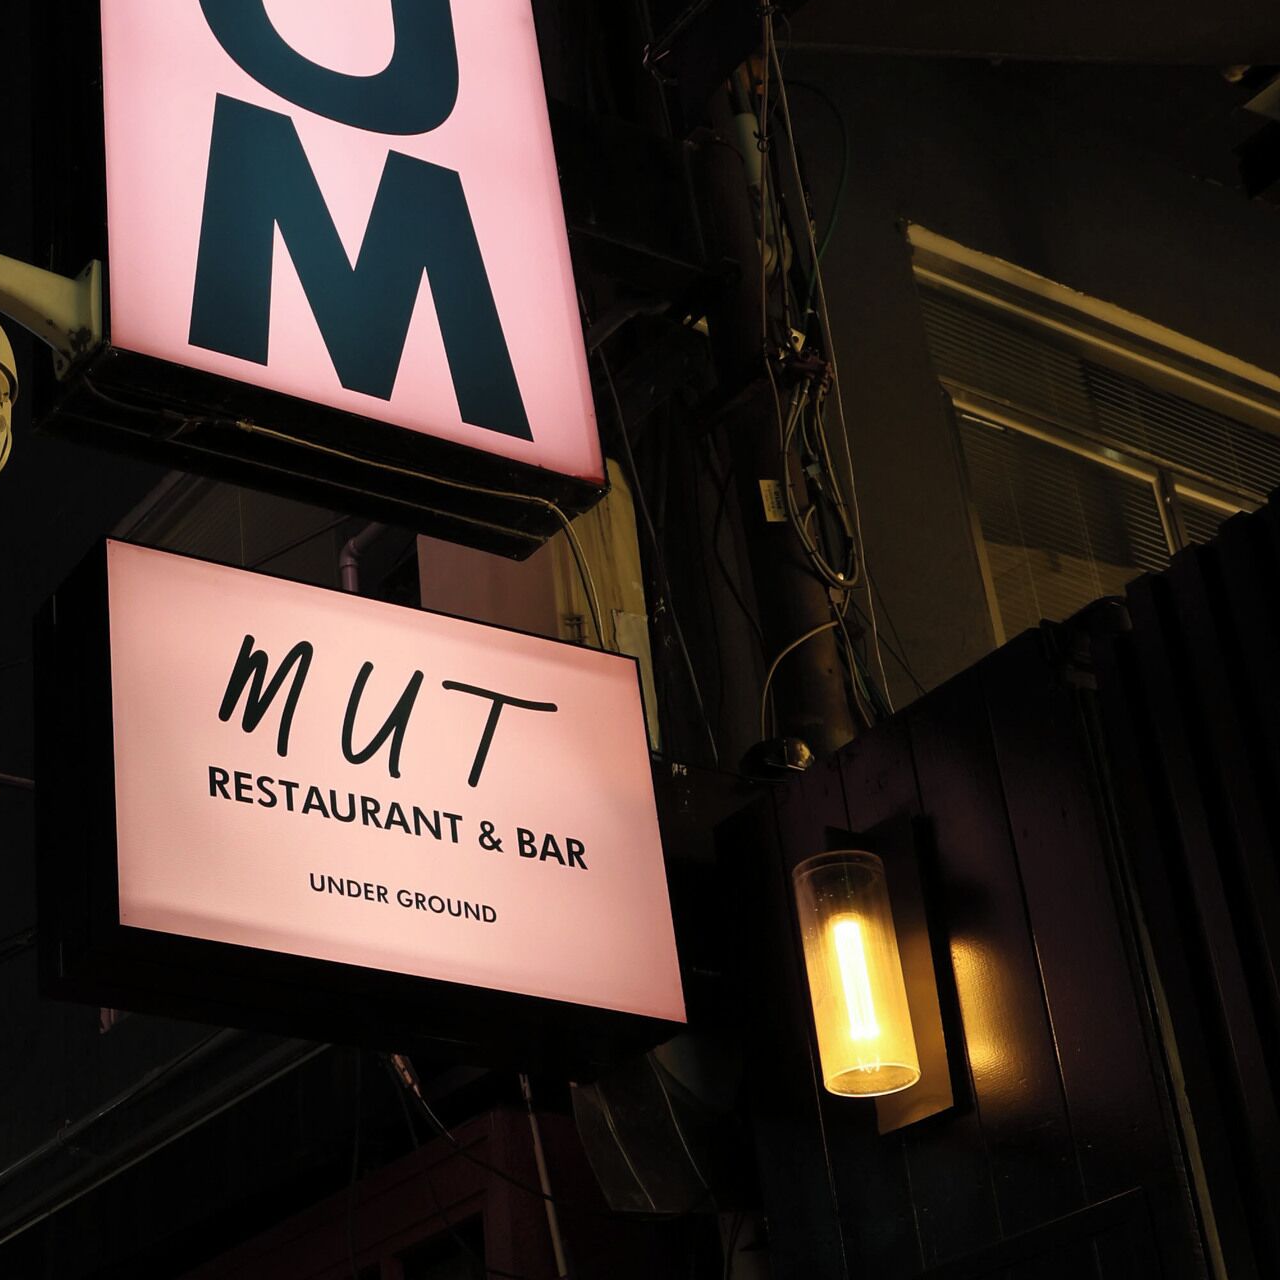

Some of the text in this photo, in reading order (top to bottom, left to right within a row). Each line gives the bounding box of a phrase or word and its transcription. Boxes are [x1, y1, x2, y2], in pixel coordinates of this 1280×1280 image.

[218, 635, 558, 787] MUT
[208, 766, 588, 870] RESTAURANT & BAR
[309, 873, 497, 924] UNDER GROUND
